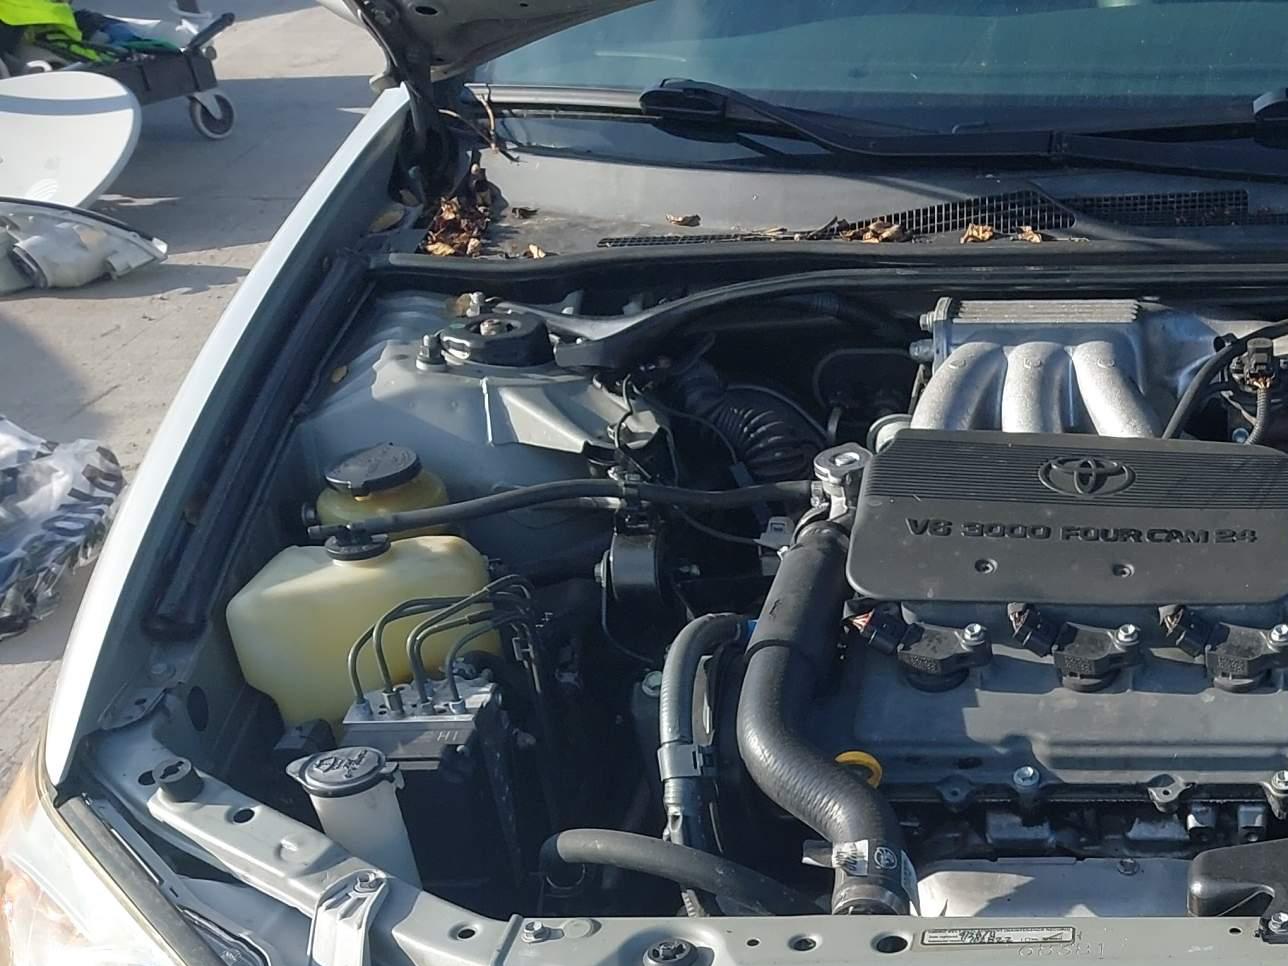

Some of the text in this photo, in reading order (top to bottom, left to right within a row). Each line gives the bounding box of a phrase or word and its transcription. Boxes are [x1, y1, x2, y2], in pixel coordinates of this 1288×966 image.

[905, 517, 1259, 544] V6 3000 FOUR CAM 24
